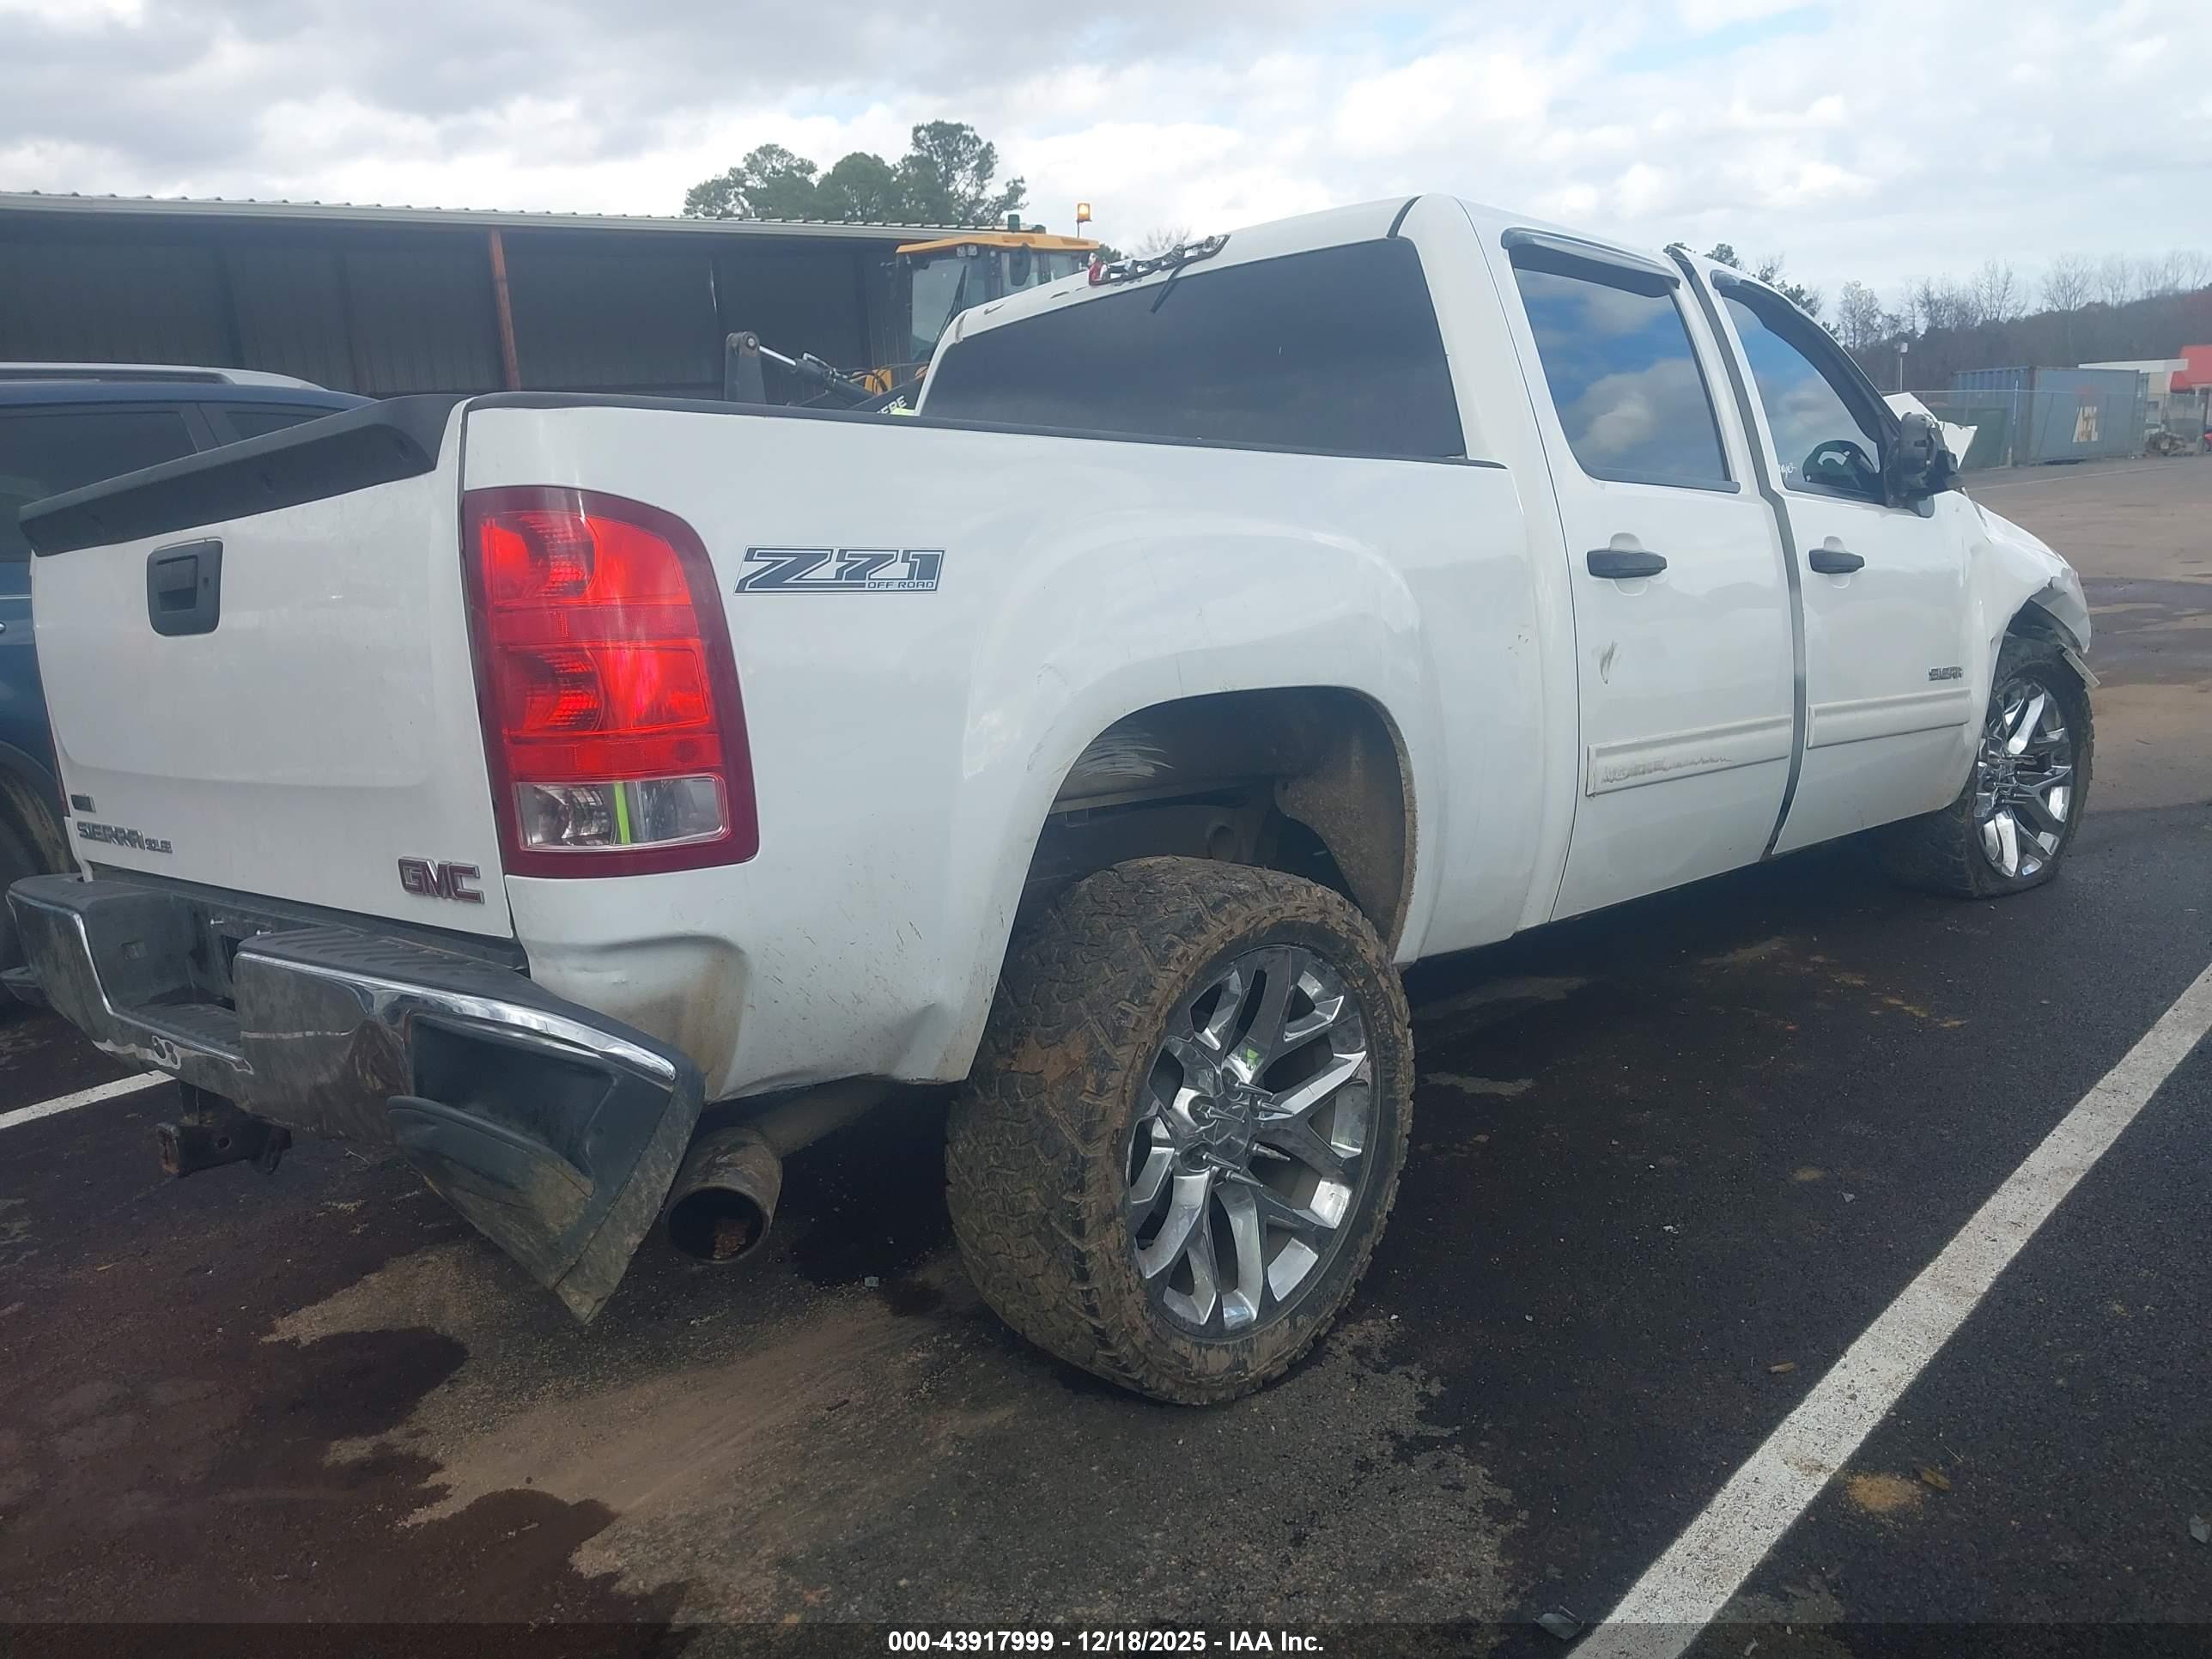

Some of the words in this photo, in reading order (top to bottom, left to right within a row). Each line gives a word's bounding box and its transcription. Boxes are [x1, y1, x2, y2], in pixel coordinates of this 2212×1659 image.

[734, 547, 945, 594] Z71
[897, 580, 934, 589] ROAD
[398, 857, 485, 904] GMC
